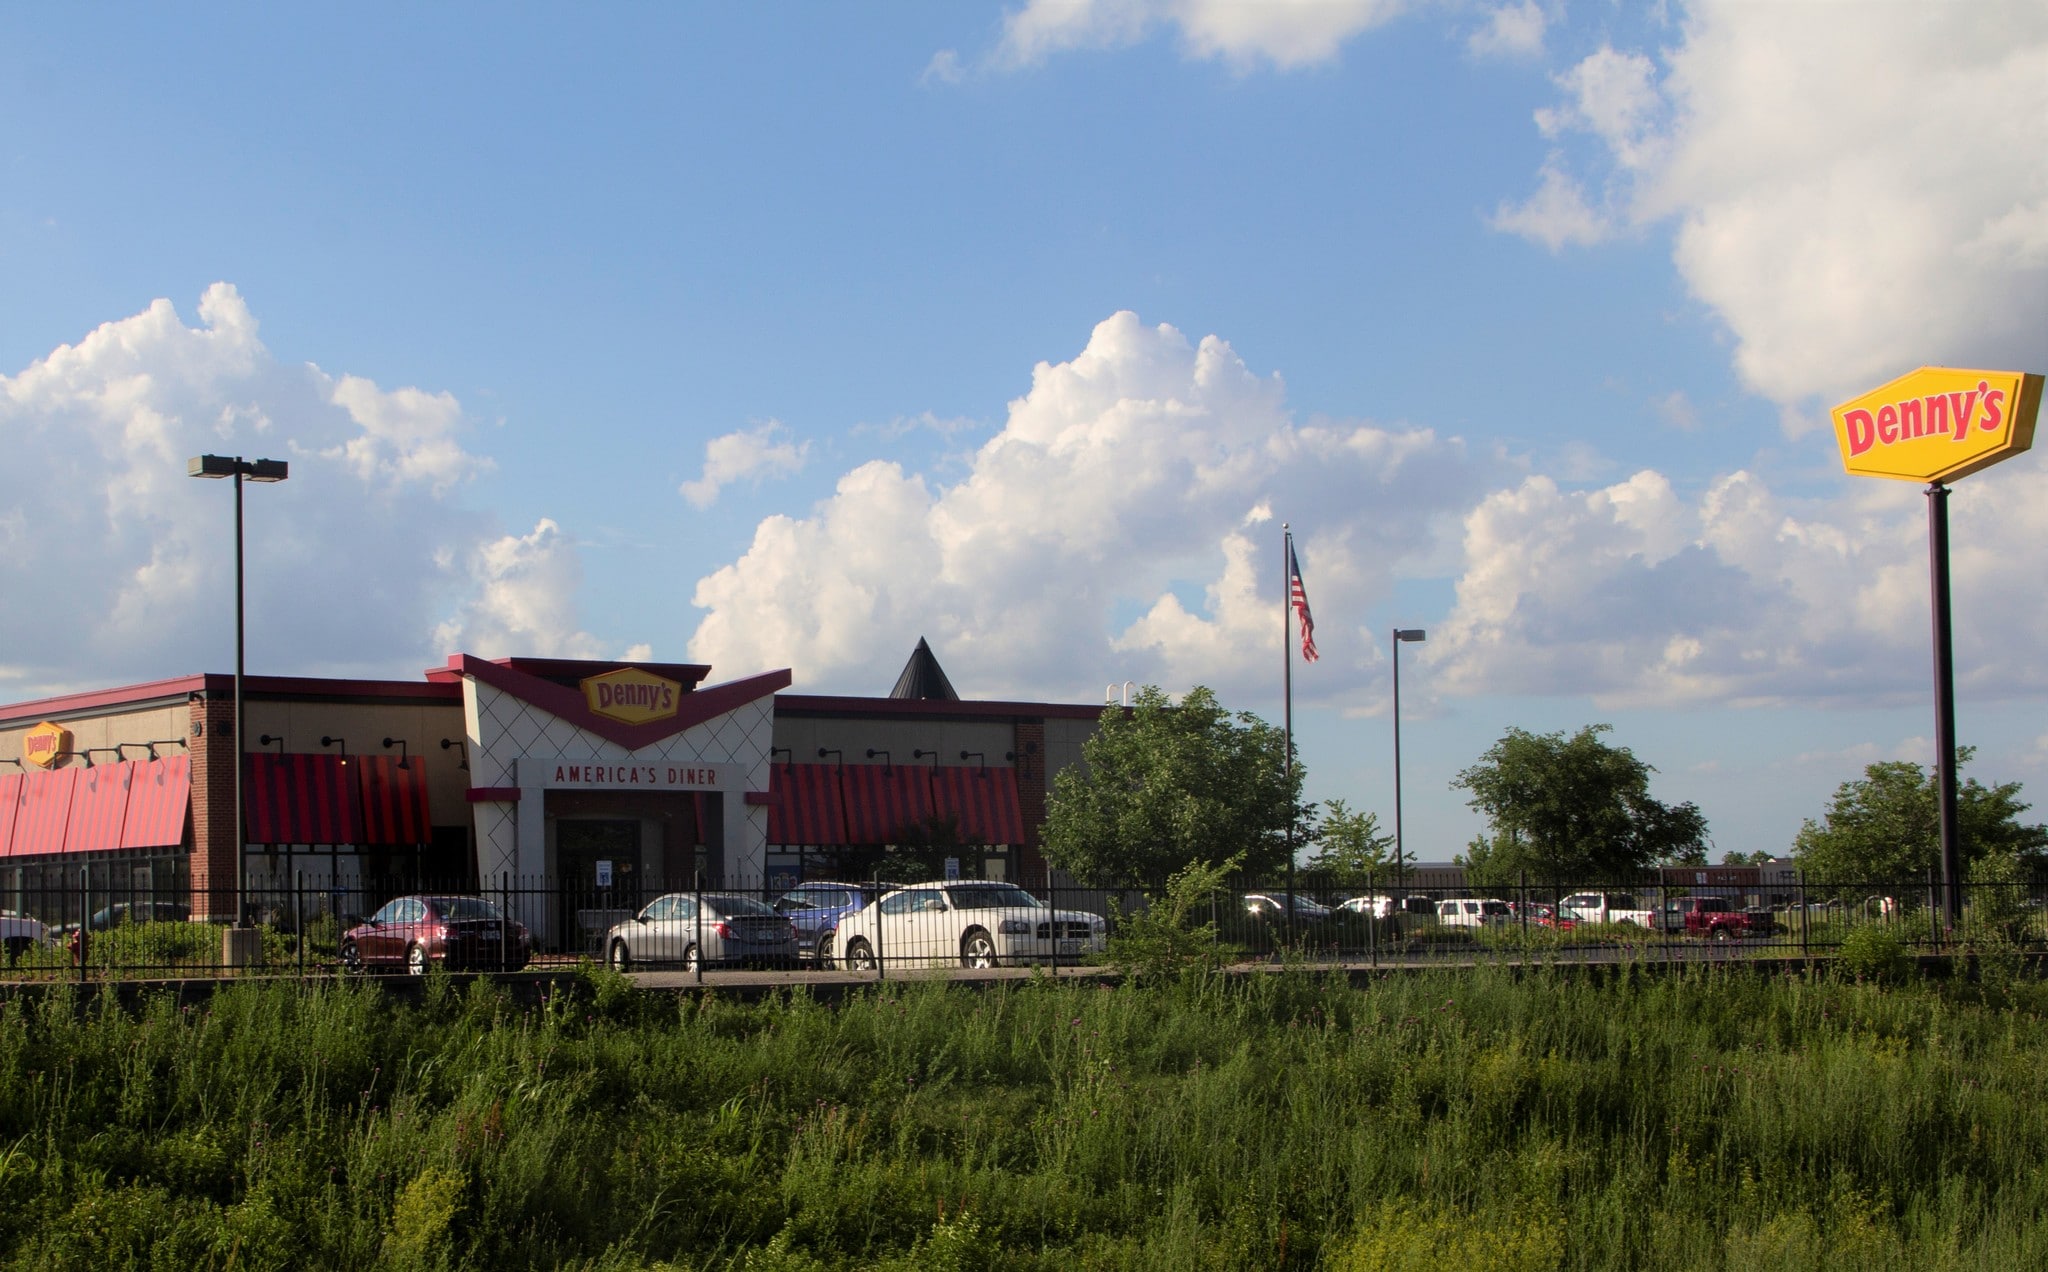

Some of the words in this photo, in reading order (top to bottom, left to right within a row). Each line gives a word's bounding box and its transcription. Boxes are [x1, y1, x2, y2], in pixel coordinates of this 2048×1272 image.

[1843, 380, 2005, 457] Denny's
[597, 682, 672, 710] Denny's
[555, 766, 656, 783] AMERICA'S
[668, 768, 715, 785] DINER
